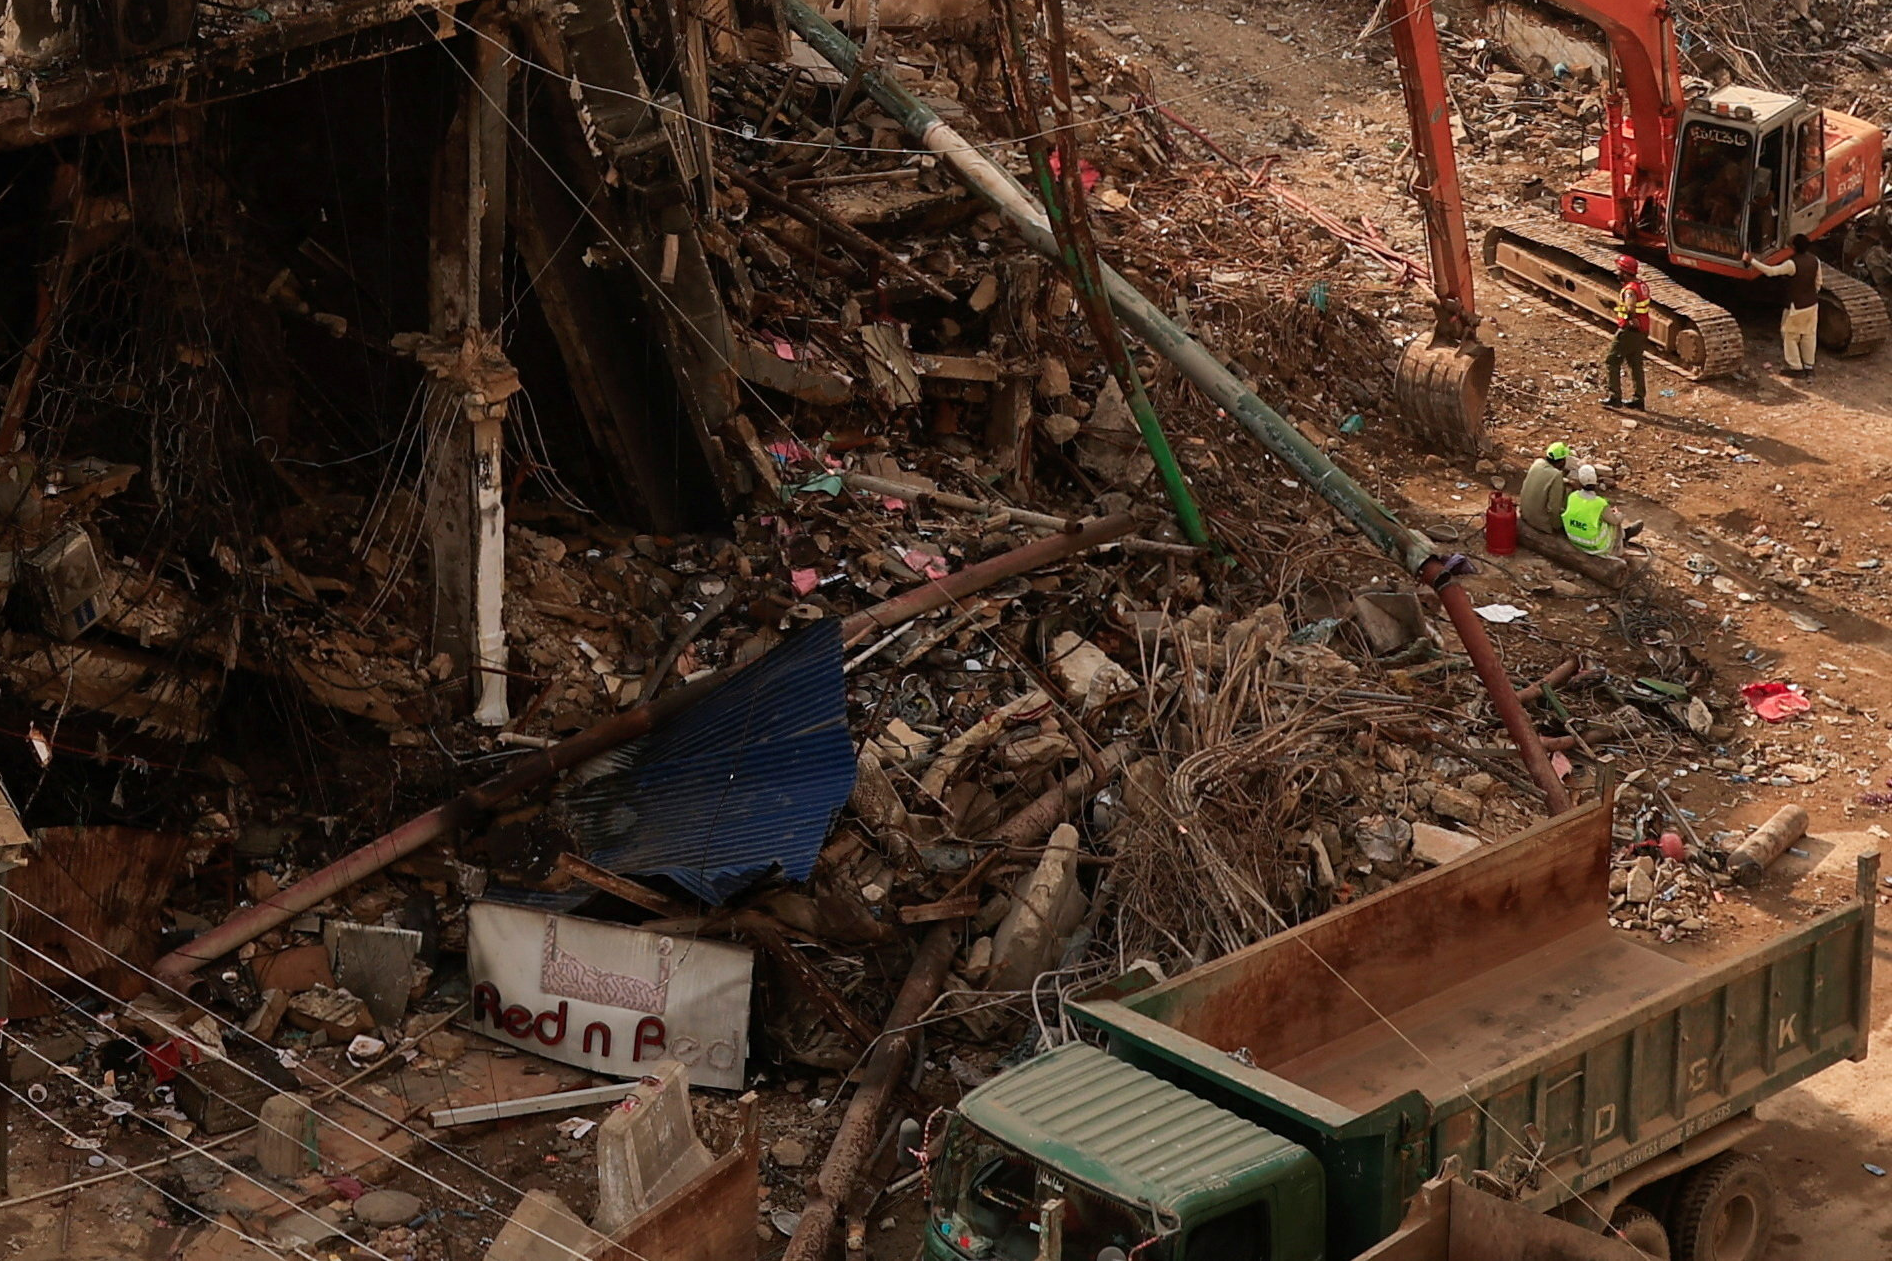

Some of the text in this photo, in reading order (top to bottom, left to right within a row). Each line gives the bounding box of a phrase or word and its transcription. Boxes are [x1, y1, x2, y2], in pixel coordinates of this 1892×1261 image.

[473, 980, 569, 1046] Red
[582, 1020, 612, 1058] n
[1594, 1103, 1616, 1140] D
[1778, 1012, 1798, 1049] K
